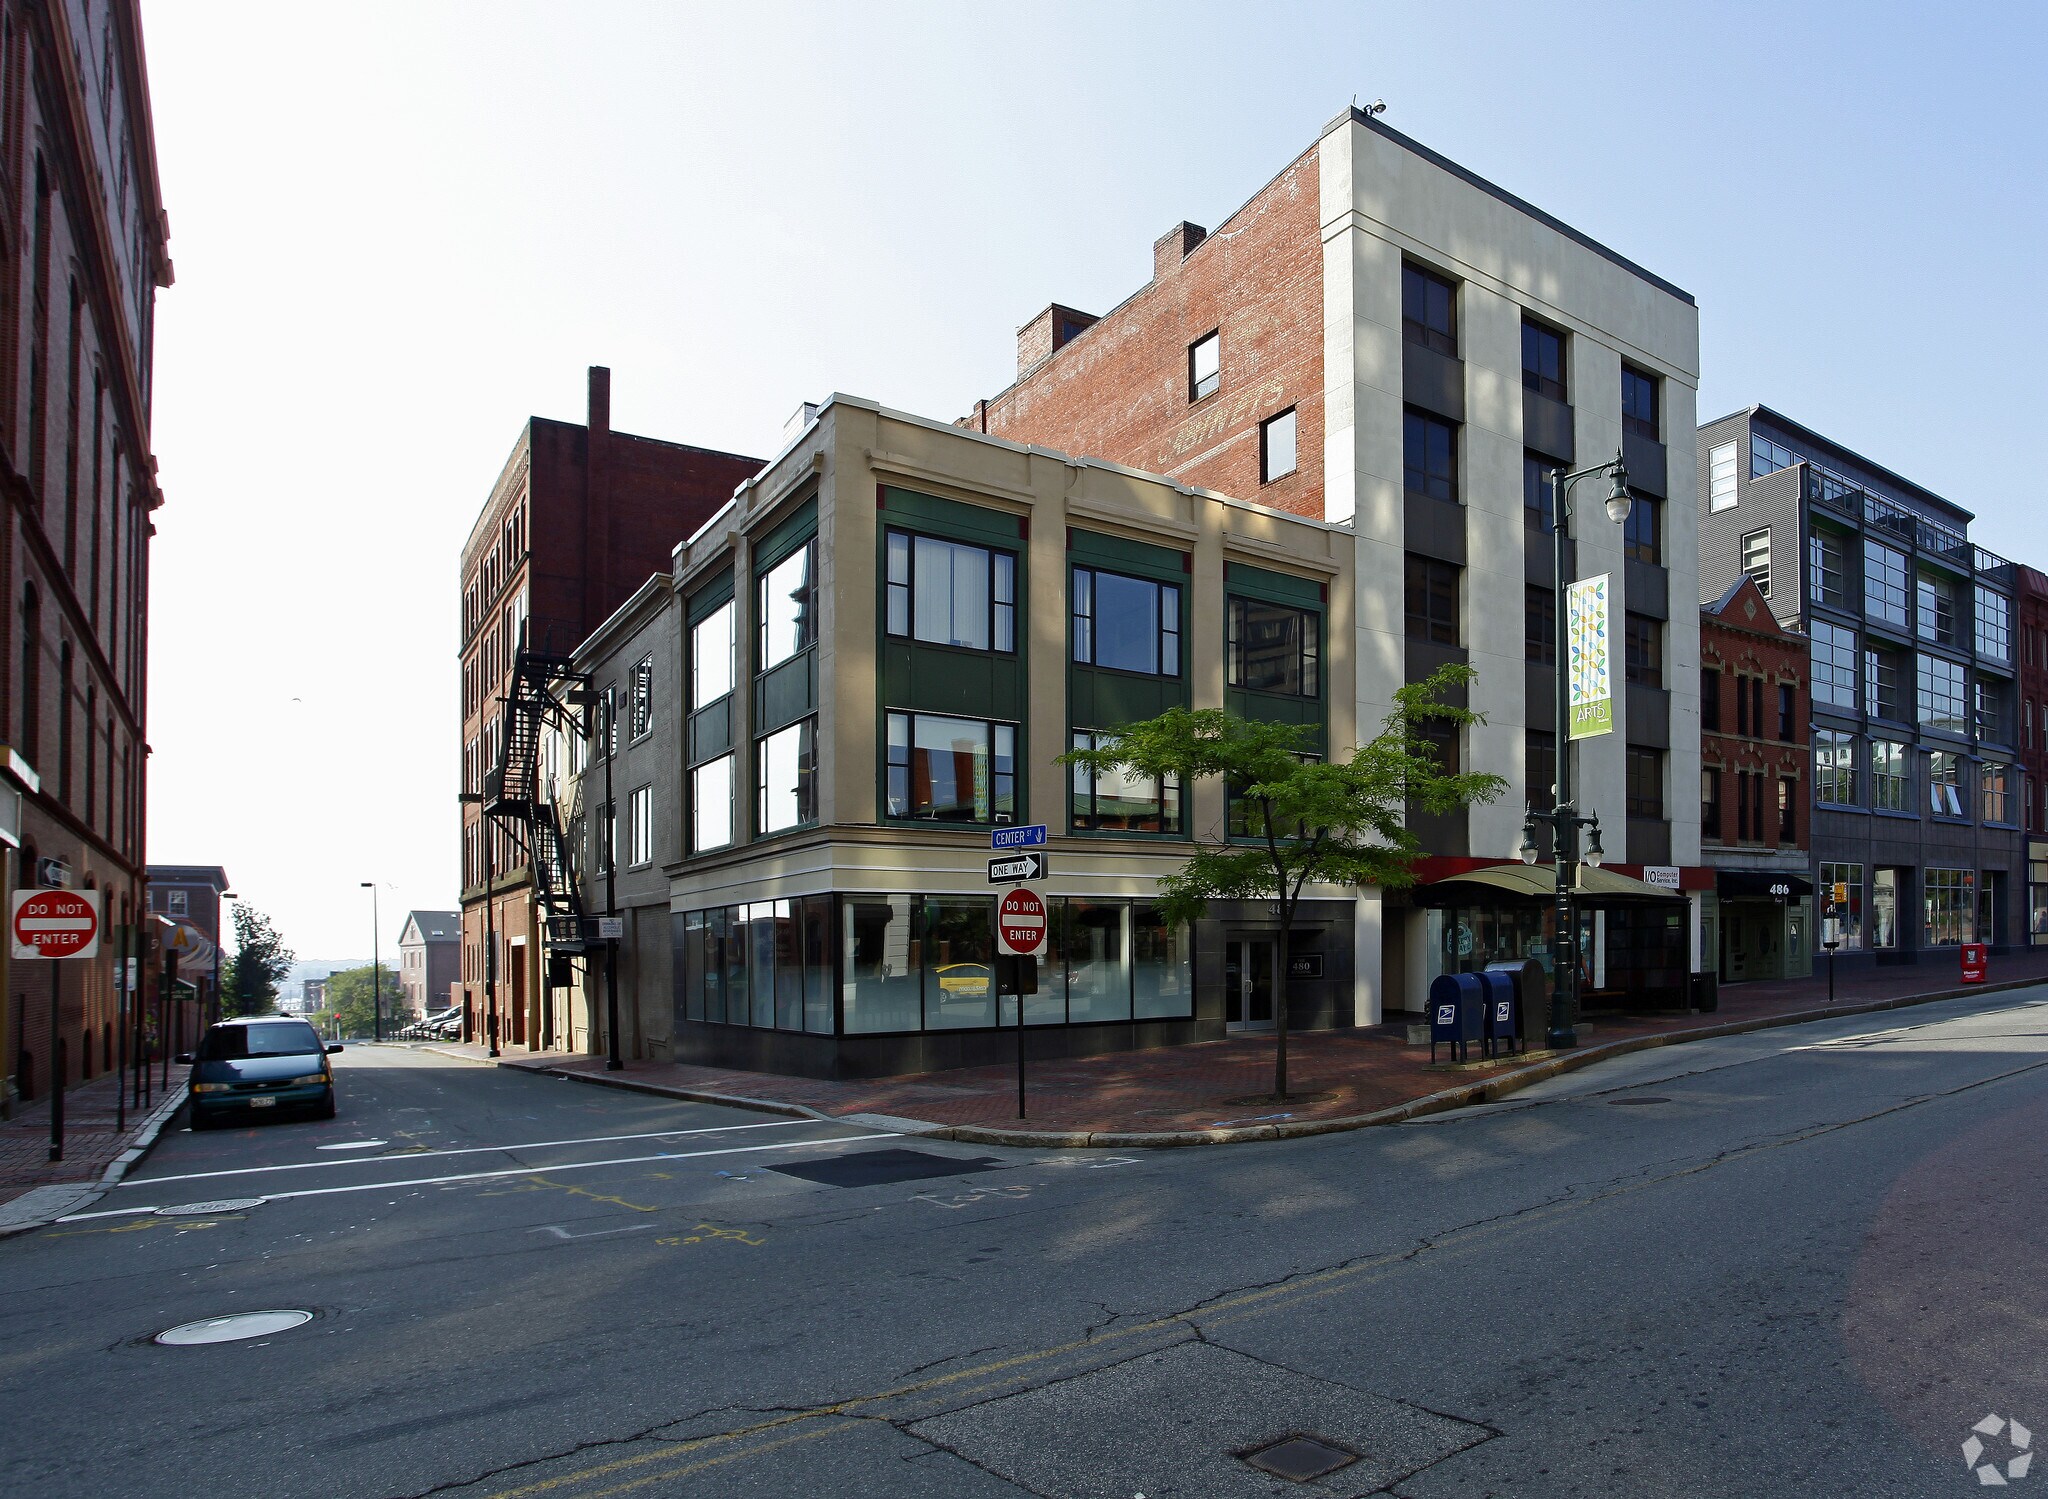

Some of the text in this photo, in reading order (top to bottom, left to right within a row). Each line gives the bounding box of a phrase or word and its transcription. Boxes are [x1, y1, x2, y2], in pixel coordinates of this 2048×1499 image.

[1576, 703, 1605, 723] ARTS
[996, 829, 1032, 845] CENTER ST
[992, 861, 1029, 877] ONE WAY
[1657, 870, 1678, 878] Computer
[1769, 884, 1790, 895] 486
[28, 903, 84, 915] DO NOT
[1006, 900, 1039, 912] DO NOT
[32, 933, 79, 945] ENTER
[1009, 930, 1037, 941] ENTER
[1292, 962, 1310, 971] 480
